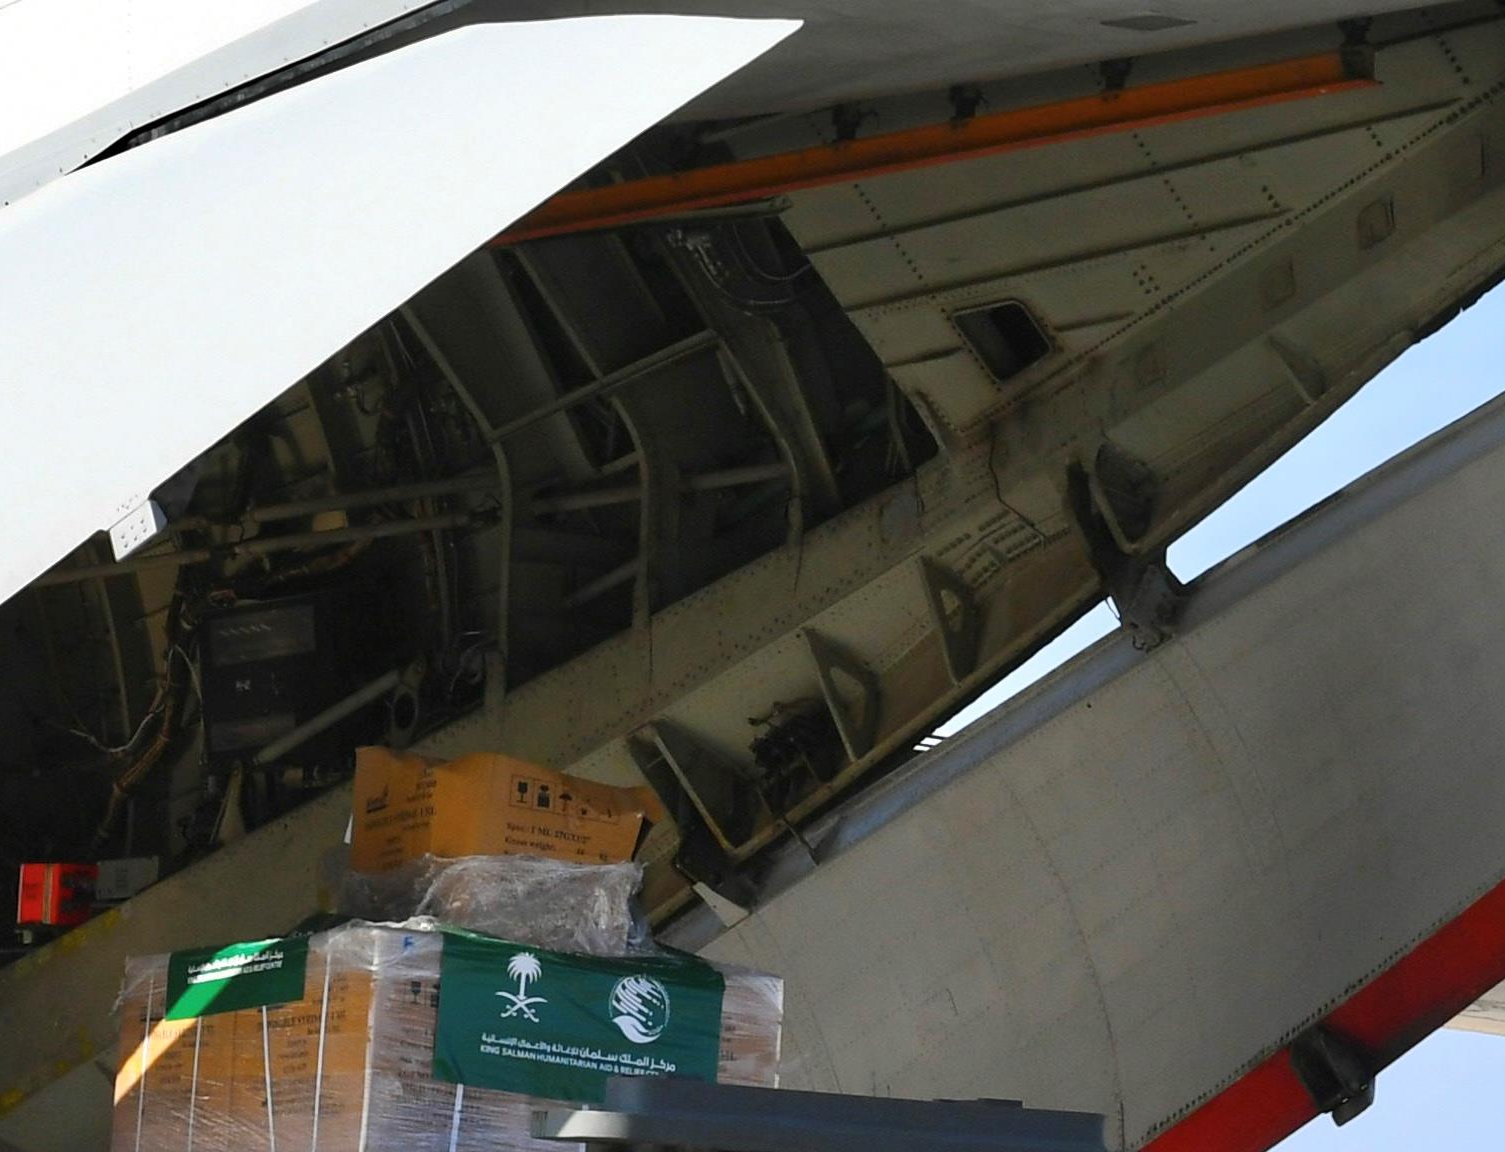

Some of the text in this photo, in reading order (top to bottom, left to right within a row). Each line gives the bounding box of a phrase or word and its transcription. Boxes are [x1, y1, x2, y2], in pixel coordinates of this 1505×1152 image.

[480, 1044, 501, 1056] KING
[502, 1047, 536, 1061] SALMAN
[537, 1054, 598, 1070] HUMANITARIAN
[599, 1062, 613, 1073] AID
[580, 1046, 618, 1061] سلمان
[619, 1053, 650, 1067] الملك
[650, 1057, 676, 1073] مركز
